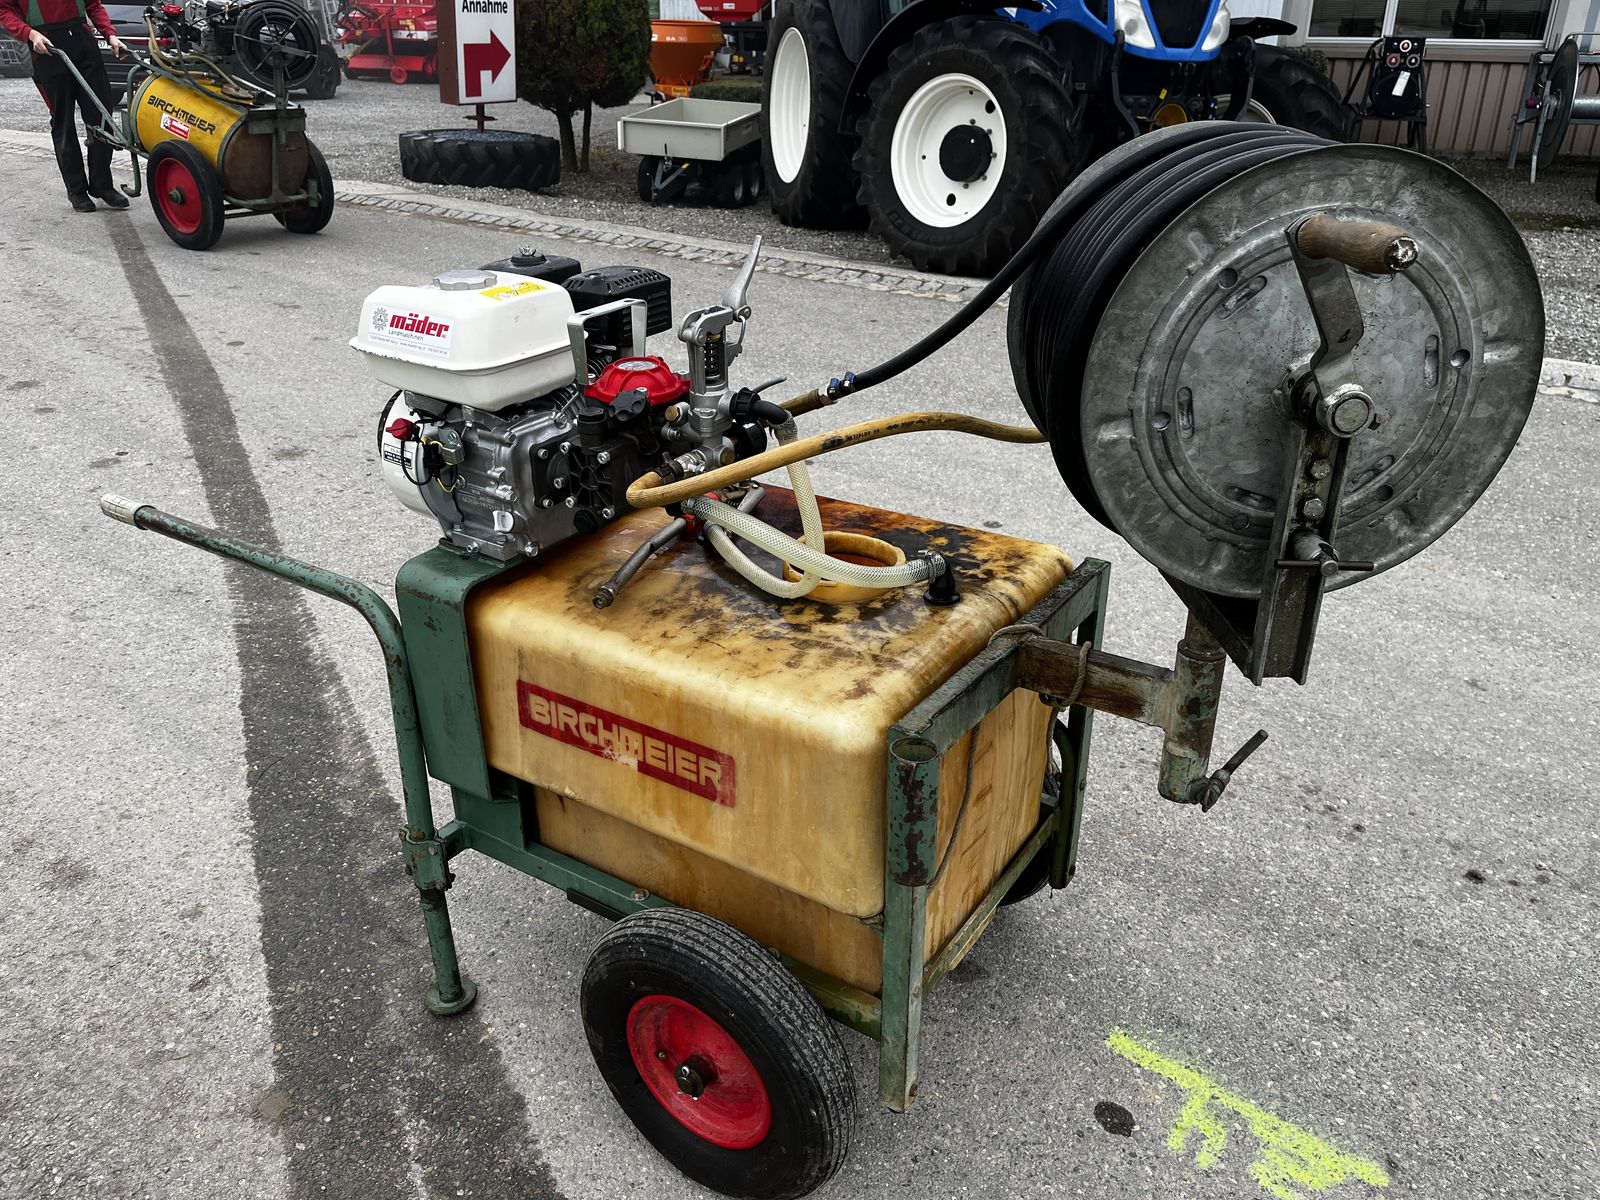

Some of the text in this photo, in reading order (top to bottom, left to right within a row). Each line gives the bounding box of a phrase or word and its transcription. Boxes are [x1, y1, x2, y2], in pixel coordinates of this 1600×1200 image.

[462, 0, 508, 13] Annahme
[147, 95, 216, 135] BIRCHMEIER
[389, 313, 450, 338] mäder
[529, 693, 721, 790] BIRCHMEIER
